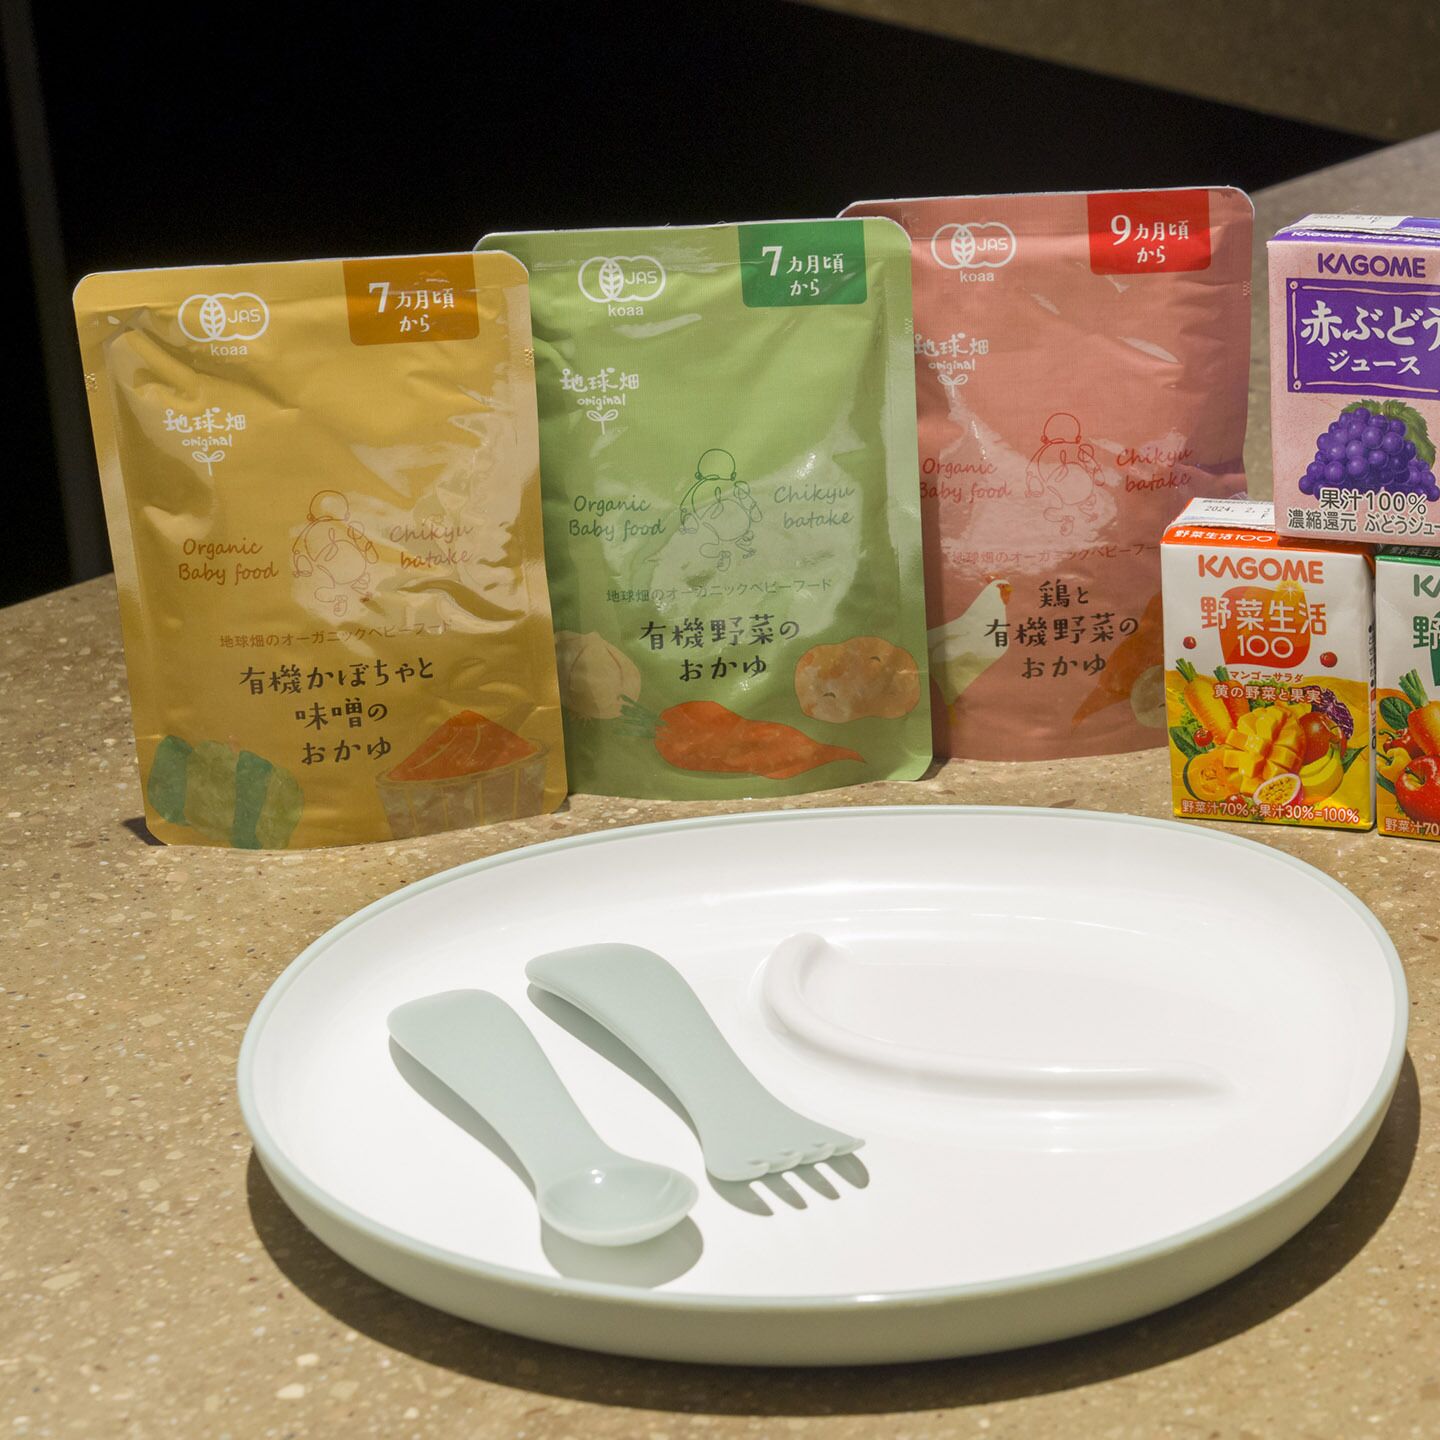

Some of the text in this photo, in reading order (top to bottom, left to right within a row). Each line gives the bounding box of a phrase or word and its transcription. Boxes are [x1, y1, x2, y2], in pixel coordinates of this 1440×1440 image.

[976, 237, 1009, 252] JAS
[1136, 245, 1167, 265] から
[959, 270, 995, 283] koaa
[1317, 253, 1426, 278] KAGOME
[625, 271, 659, 286] JAS
[789, 278, 821, 297] から
[227, 308, 260, 324] JAS
[607, 303, 644, 317] koaa
[399, 313, 431, 333] から
[210, 343, 248, 358] koaa
[928, 359, 976, 373] original
[1327, 348, 1421, 376] ジュース
[559, 367, 640, 392] 地球畑
[577, 394, 627, 410] original
[163, 408, 246, 433] 地球畑
[182, 434, 233, 449] original
[922, 457, 998, 480] Organic
[1117, 448, 1193, 468] Chikyu
[773, 483, 856, 504] Chikyu
[968, 479, 1012, 504] food
[1125, 472, 1193, 493] batake
[573, 495, 652, 516] Organic
[1320, 489, 1427, 515] 果汁100%
[568, 518, 666, 541] Baby food
[783, 510, 854, 530] batake
[1287, 508, 1357, 532] 濃縮還元
[389, 522, 475, 546] Chikyu
[1172, 528, 1274, 543] 野菜生活100
[183, 538, 263, 560] Organic
[400, 548, 473, 570] batake
[178, 561, 280, 587] Baby food
[1197, 554, 1325, 584] KAGOME
[1038, 578, 1090, 609] 鶏と
[1200, 595, 1328, 636] 野菜生活
[640, 613, 801, 651] 有機野菜の
[984, 612, 1140, 648] 有機野菜の
[1237, 634, 1294, 659] 100
[239, 657, 435, 695] 有機かぼちゃと
[679, 654, 768, 682] おかゆ
[1021, 652, 1107, 679] おかゆ
[1230, 670, 1305, 684] マンゴーサラダ
[1213, 683, 1323, 704] 黄の野菜と果実
[295, 698, 389, 730] 味噌の
[300, 736, 392, 766] おかゆ
